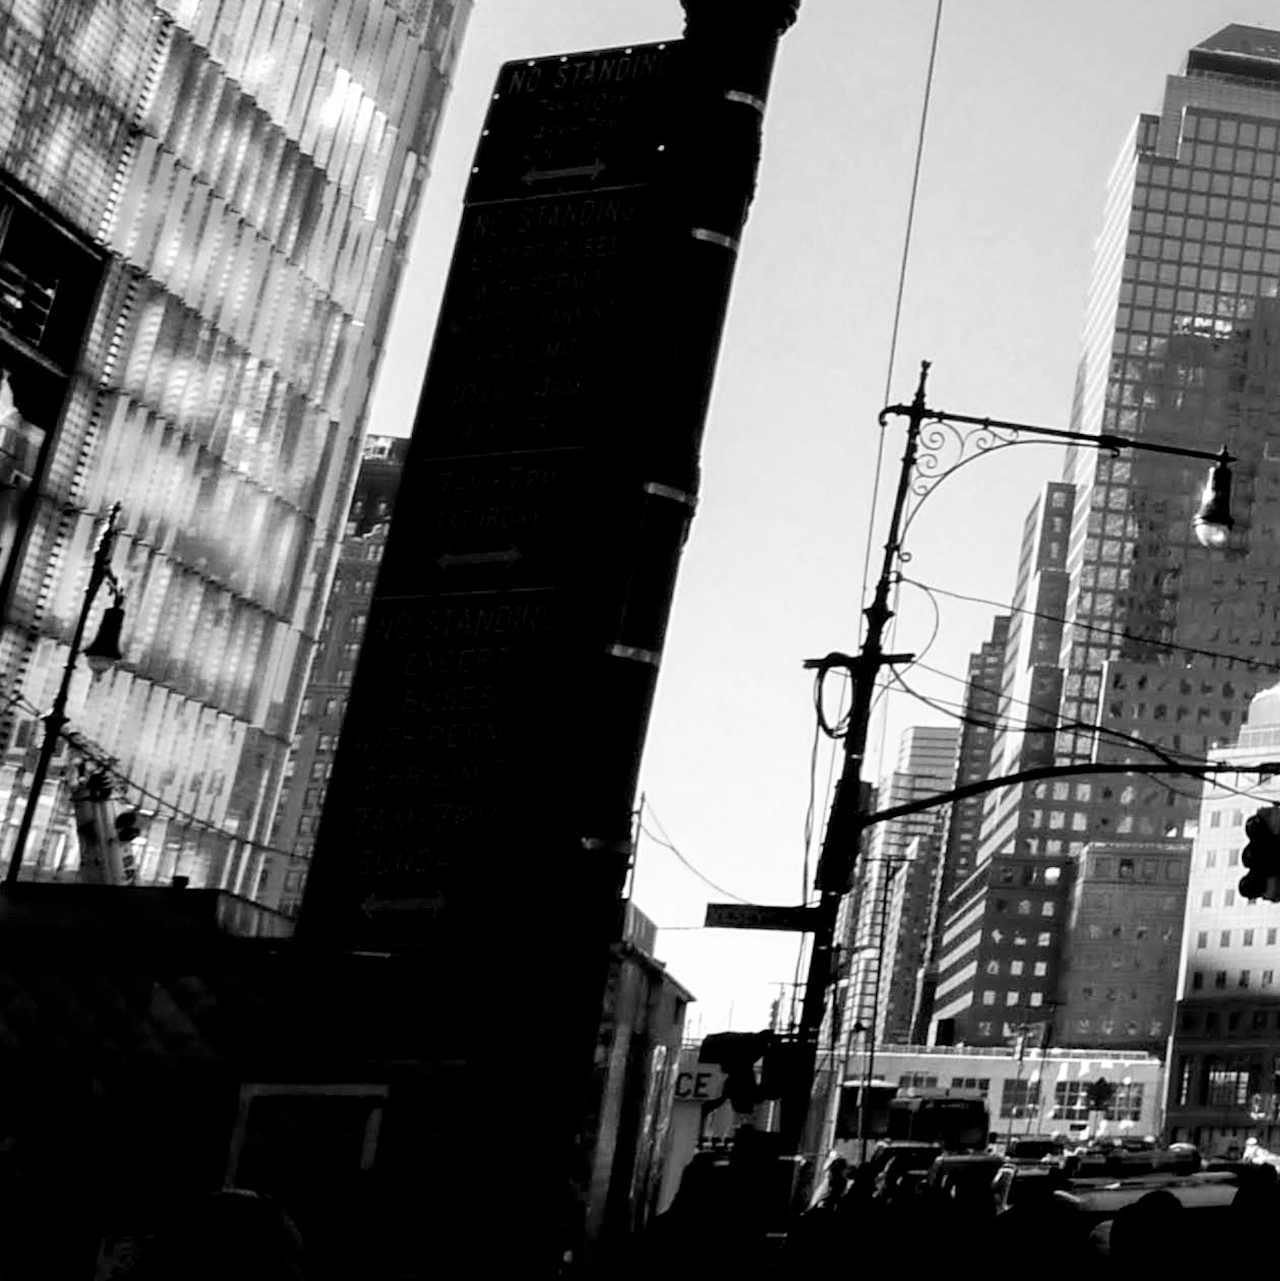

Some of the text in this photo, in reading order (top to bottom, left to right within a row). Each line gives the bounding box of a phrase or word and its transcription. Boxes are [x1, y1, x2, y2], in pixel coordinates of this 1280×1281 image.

[507, 53, 671, 94] NO STANDING
[516, 196, 637, 235] STANDING
